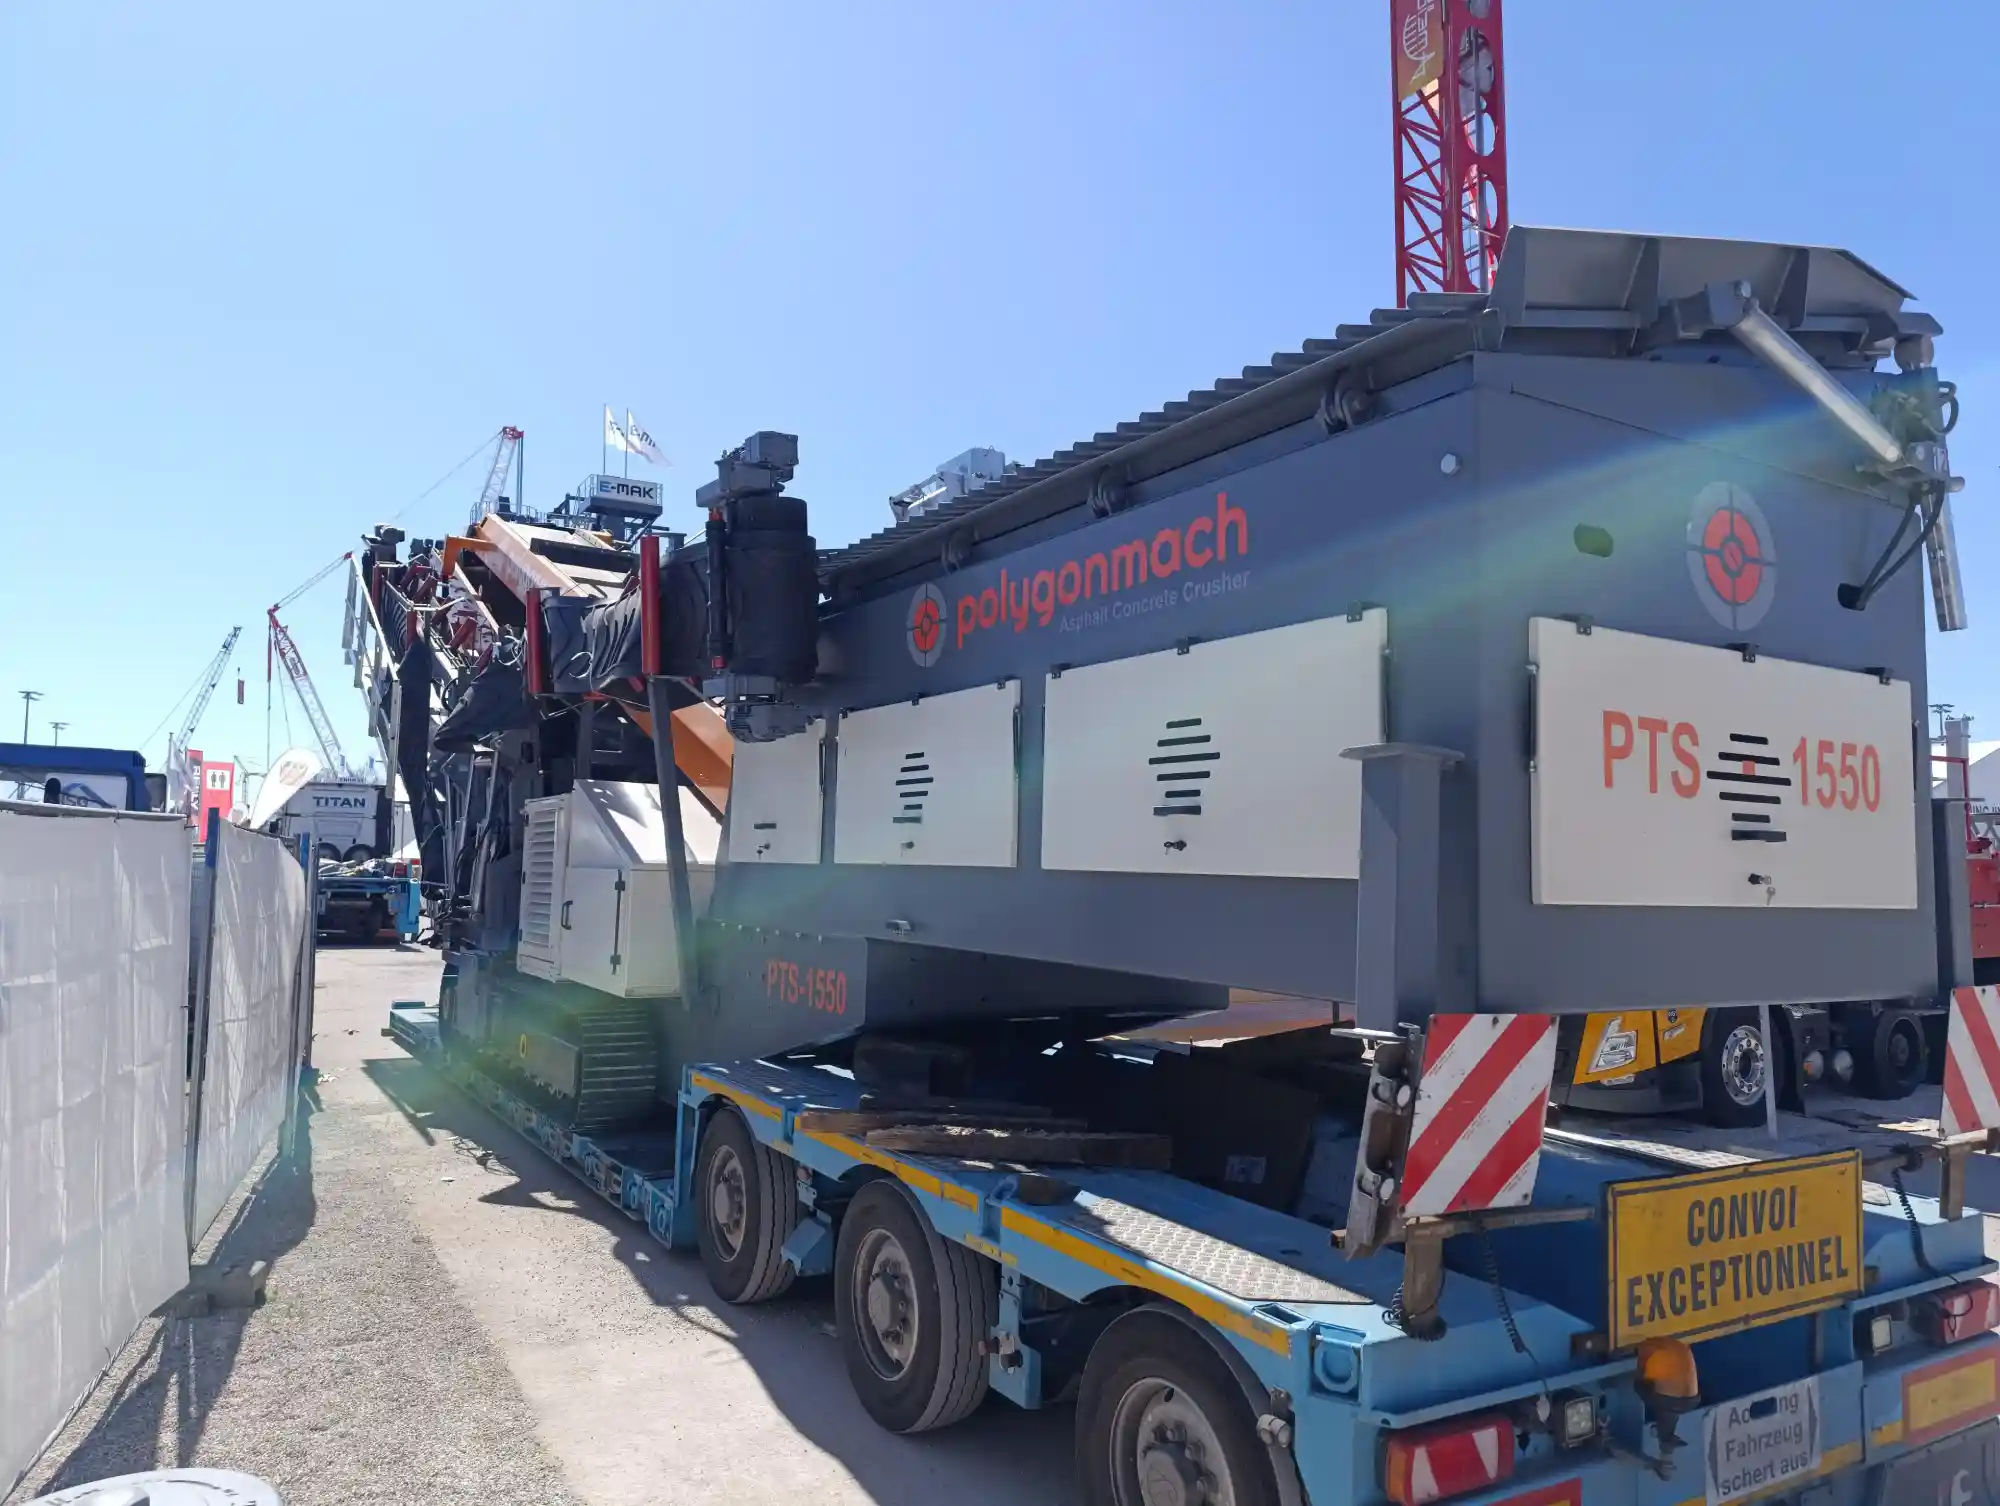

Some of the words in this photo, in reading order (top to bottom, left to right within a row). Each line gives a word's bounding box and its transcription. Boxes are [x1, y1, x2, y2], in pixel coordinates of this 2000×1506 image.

[600, 481, 654, 499] E-MAK
[957, 492, 1249, 649] polygonmach
[1060, 603, 1109, 633] Asphalt
[1112, 588, 1178, 620] Concrete
[1182, 570, 1251, 602] Crusher
[1602, 709, 1701, 799] PTS
[1792, 735, 1880, 813] 1550
[312, 796, 366, 809] TITAN
[766, 961, 848, 1016] PTS-1550
[1687, 1185, 1798, 1247] CONVOI
[1627, 1235, 1849, 1327] EXCEPTIONNEL
[1727, 1393, 1800, 1430] Acng
[1724, 1421, 1804, 1462] Fahrzeug
[1720, 1460, 1776, 1496] schert
[1780, 1450, 1809, 1476] aus
